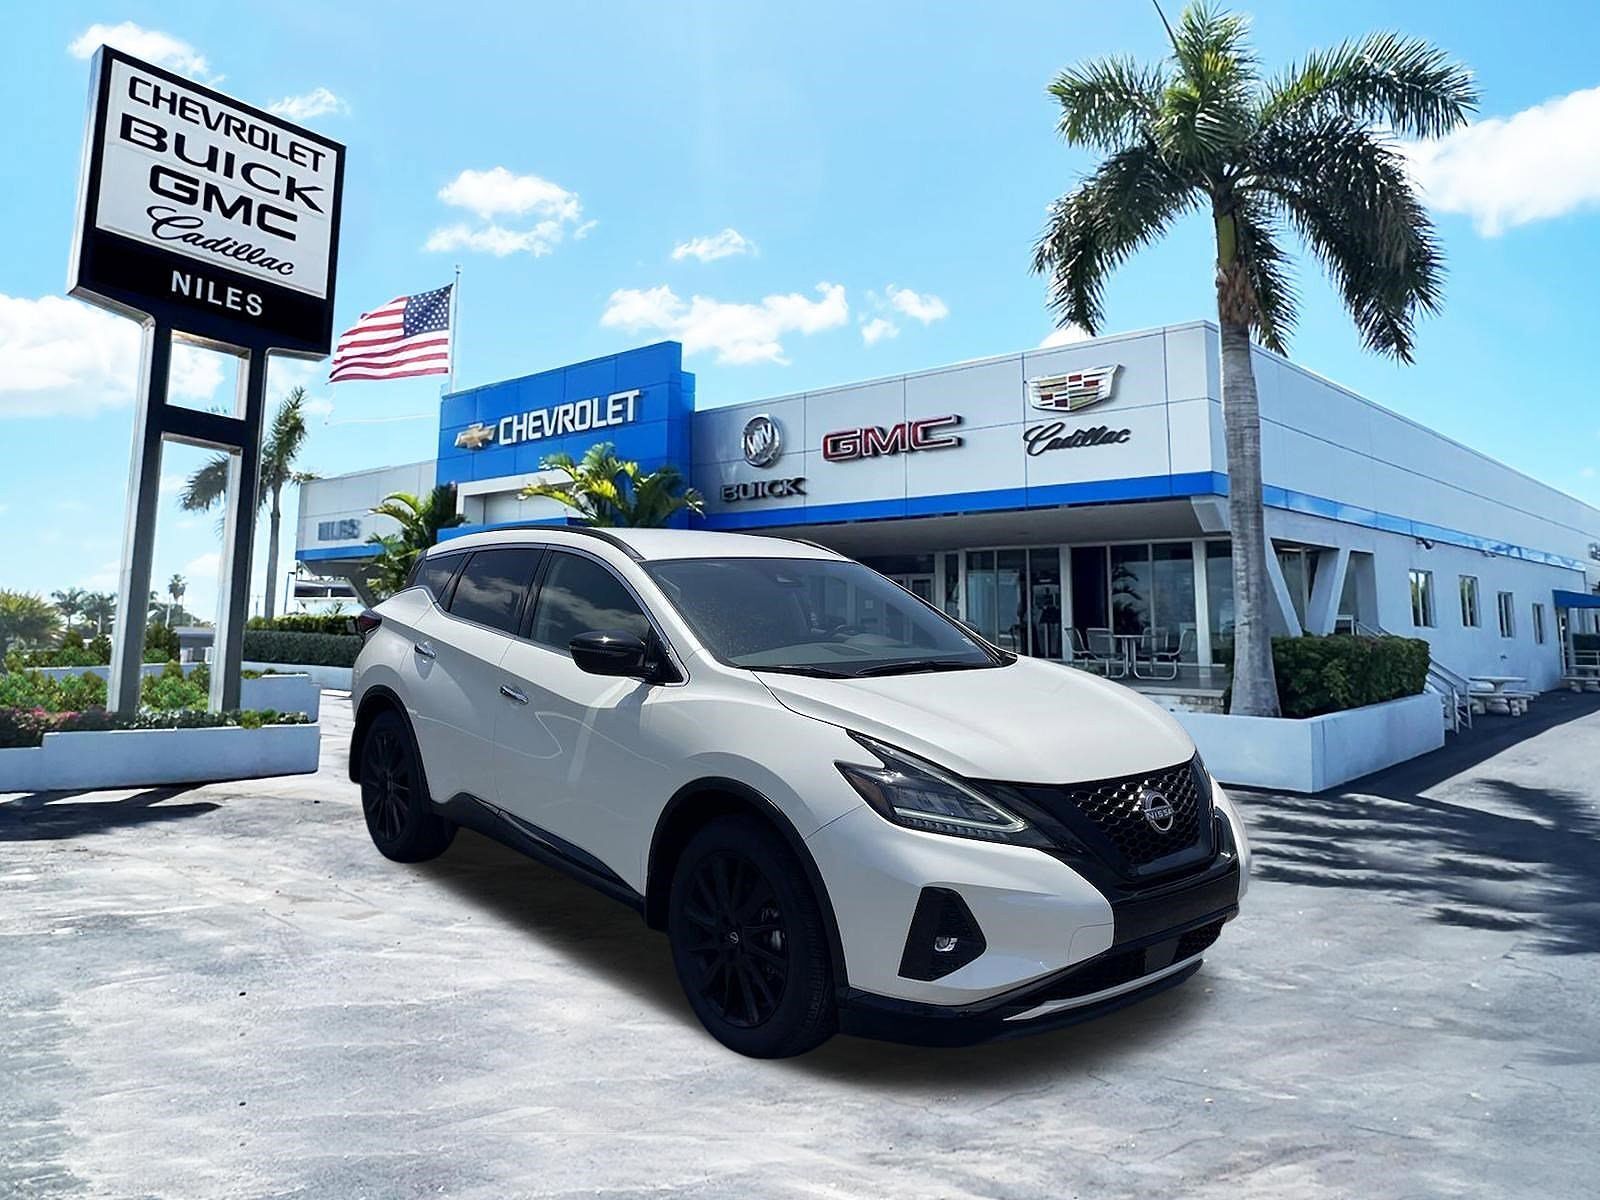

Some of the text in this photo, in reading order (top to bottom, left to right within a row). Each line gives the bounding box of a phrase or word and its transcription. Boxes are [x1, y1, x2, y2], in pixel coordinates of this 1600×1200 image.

[128, 75, 325, 172] CHEVROLET
[119, 112, 325, 214] BUICK
[149, 164, 298, 241] GMC
[146, 205, 294, 276] Cadillac
[171, 270, 263, 316] NILES
[498, 388, 641, 446] CHEVROLET
[822, 414, 963, 463] GMC
[1023, 421, 1132, 457] Cadillac
[720, 476, 807, 502] BUICK
